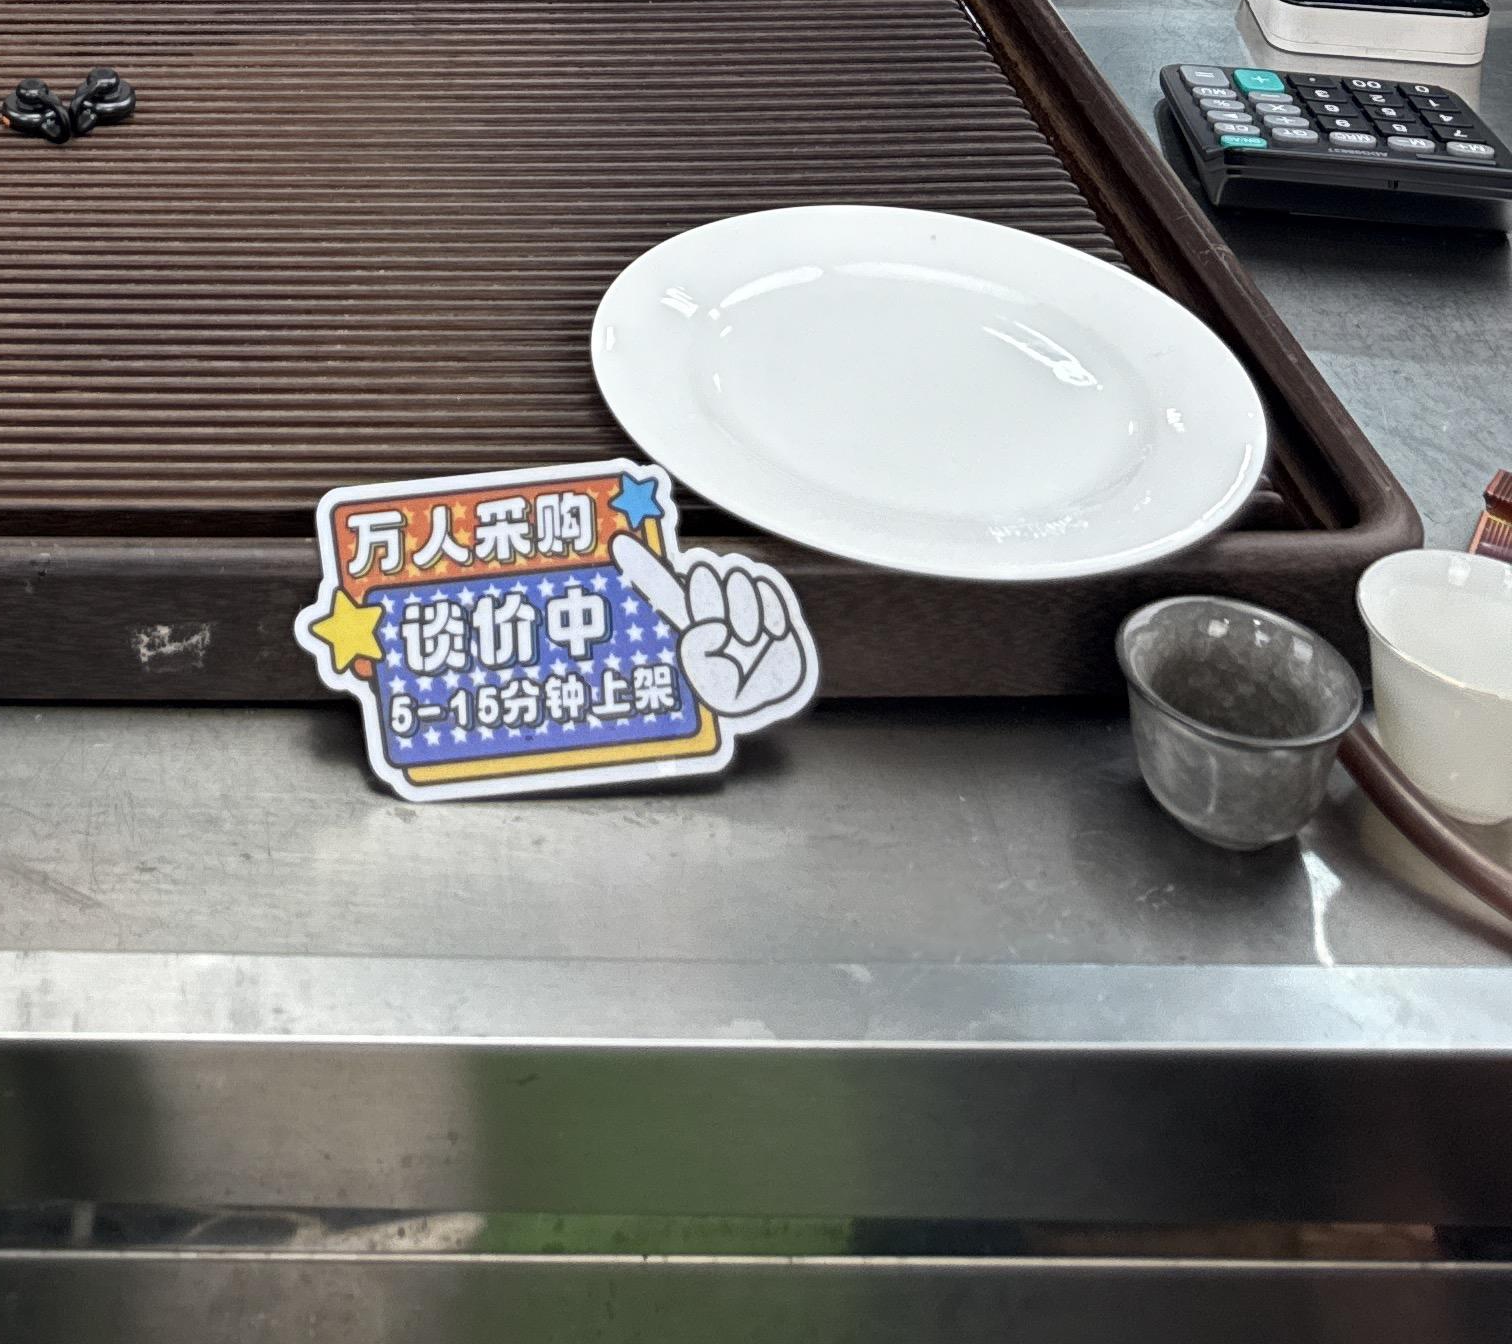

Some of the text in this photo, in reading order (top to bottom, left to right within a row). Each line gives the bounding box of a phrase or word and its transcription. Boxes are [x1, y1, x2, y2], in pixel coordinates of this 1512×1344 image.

[346, 493, 594, 578] 万人采购
[400, 586, 611, 676] 谈价中
[389, 664, 678, 734] 5-15分钟上架
